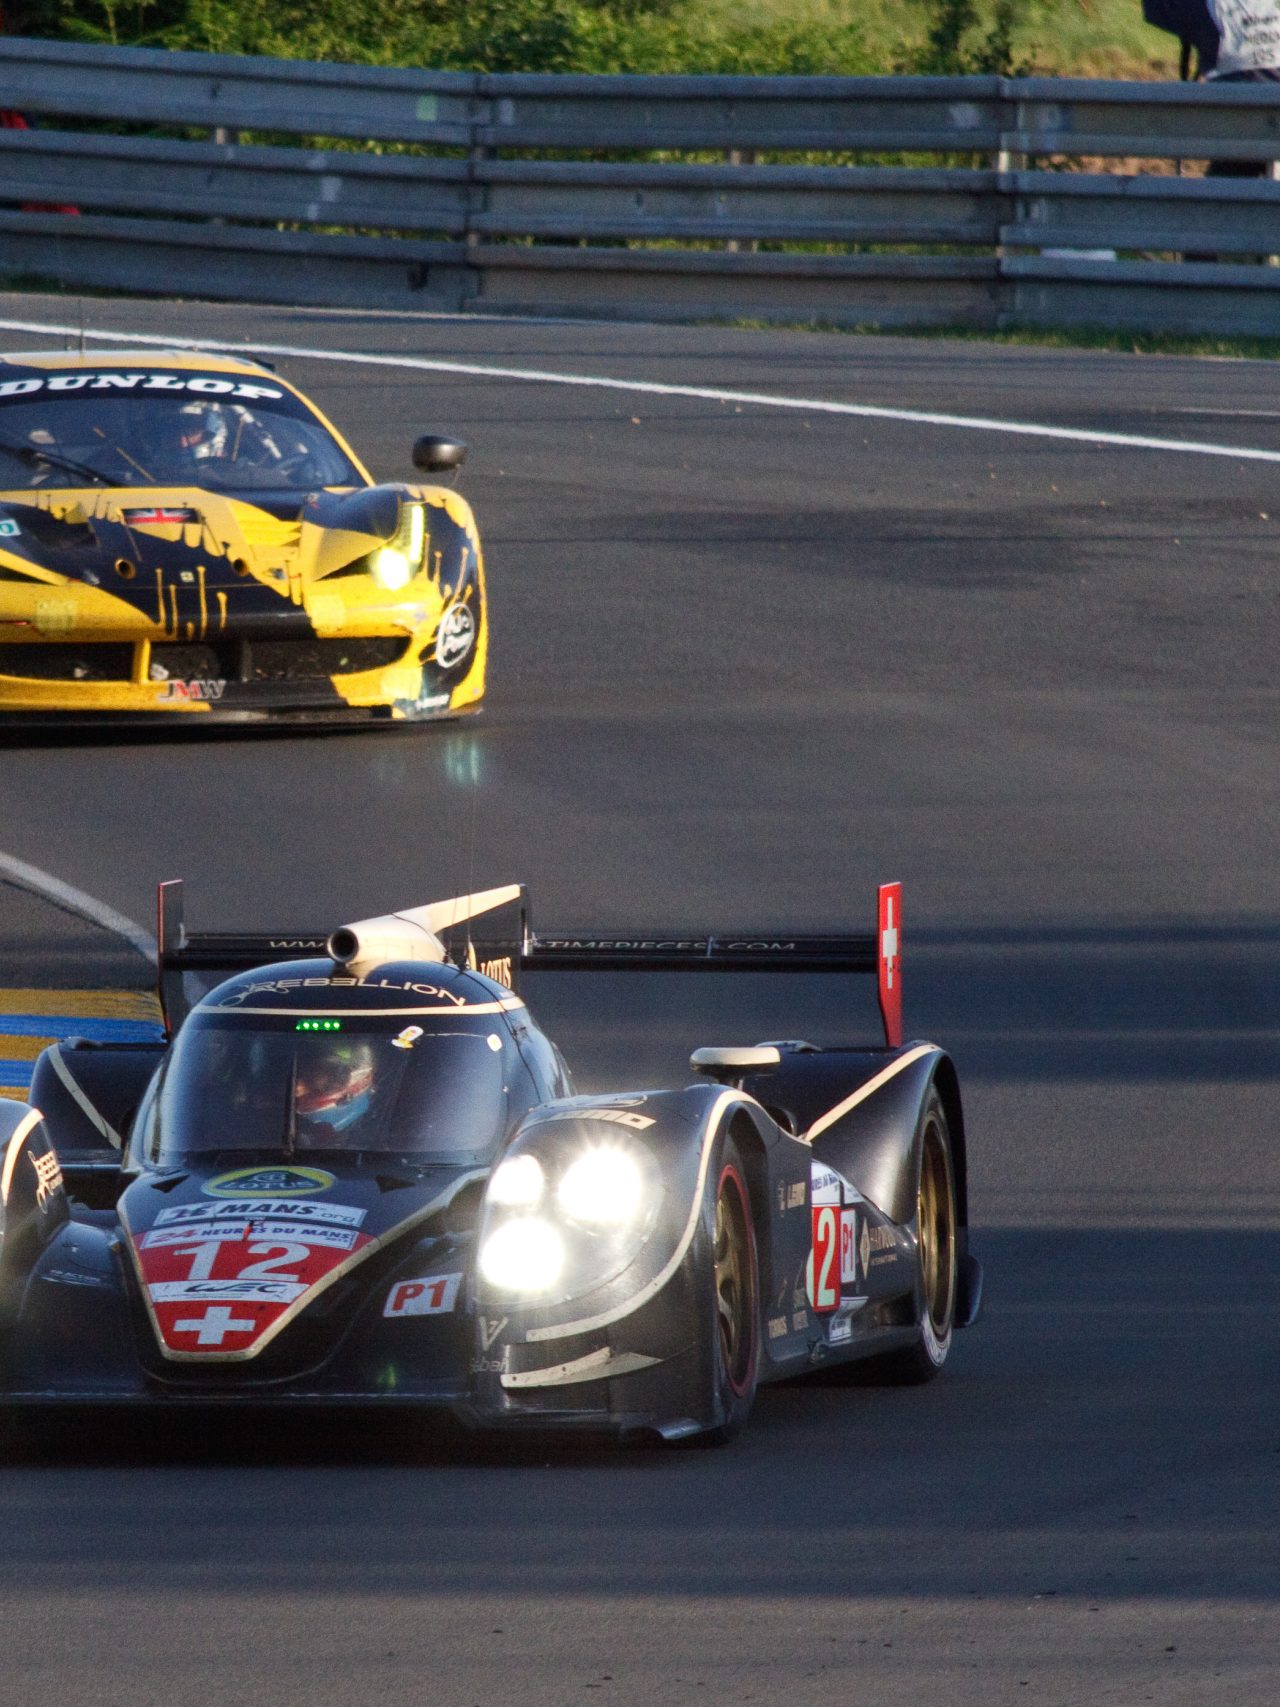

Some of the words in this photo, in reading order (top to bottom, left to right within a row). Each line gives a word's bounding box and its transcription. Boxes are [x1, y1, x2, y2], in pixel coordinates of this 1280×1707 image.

[156, 680, 227, 702] JMW
[249, 977, 466, 1006] REBELLION
[221, 1181, 317, 1190] LOTUS
[218, 1203, 317, 1215] MANS
[272, 1227, 296, 1235] DU
[300, 1228, 351, 1240] MANS
[173, 1241, 310, 1282] 12
[183, 1281, 288, 1293] WEC
[391, 1279, 448, 1312] P1
